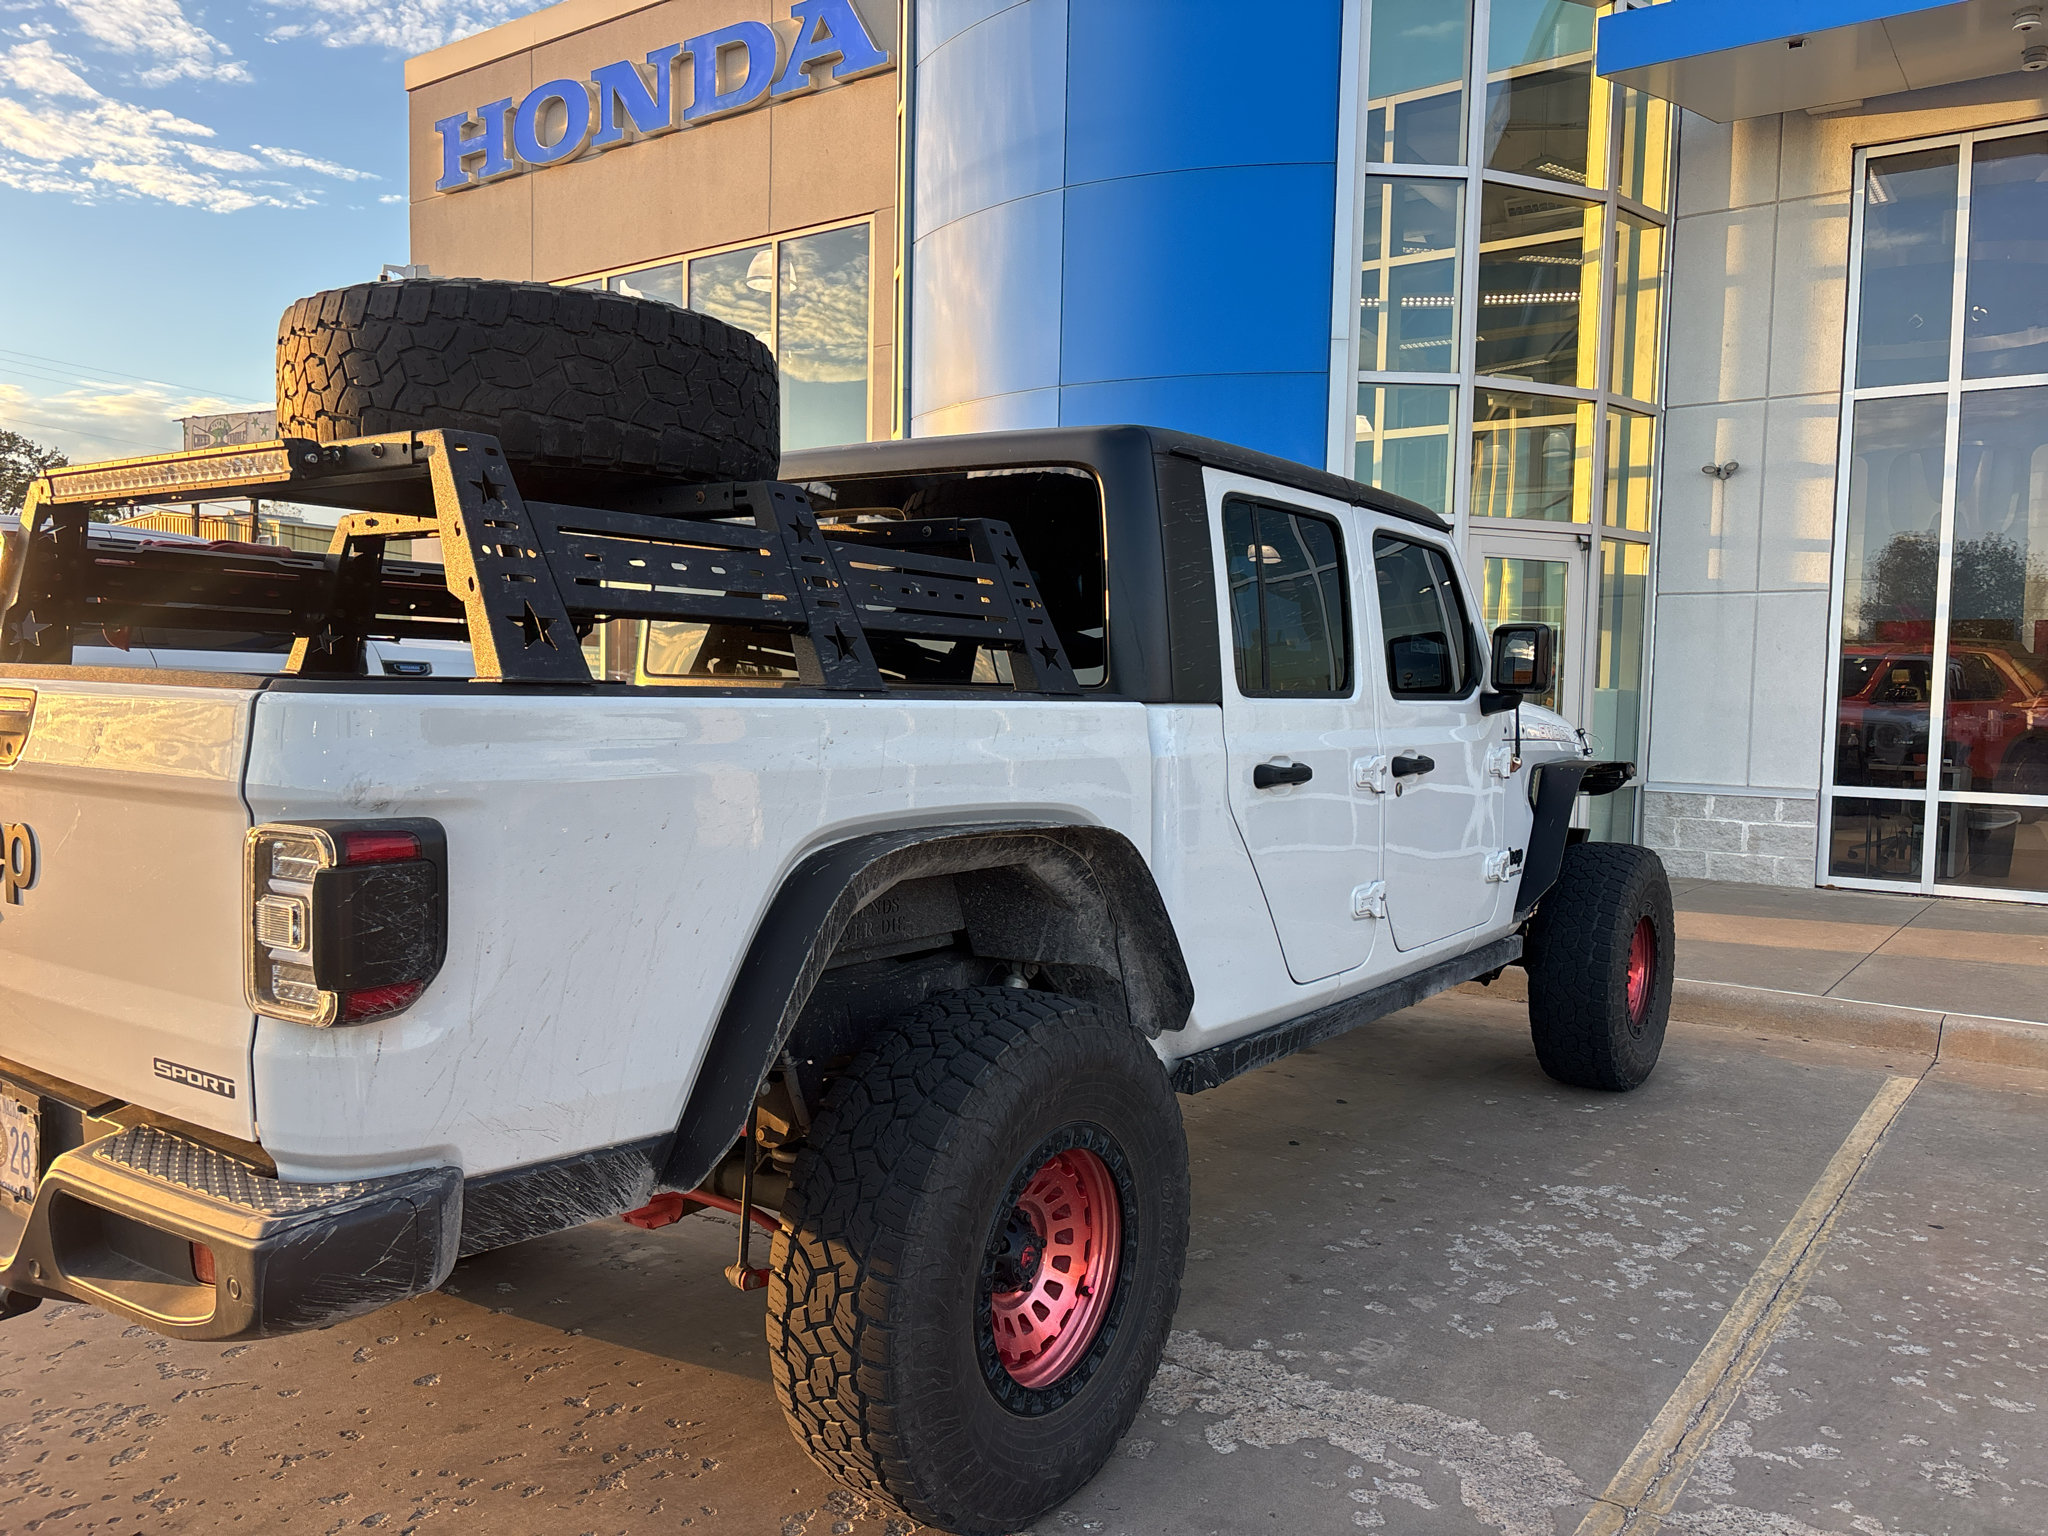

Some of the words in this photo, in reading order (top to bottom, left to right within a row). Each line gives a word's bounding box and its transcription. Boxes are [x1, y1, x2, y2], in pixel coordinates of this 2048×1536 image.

[434, 0, 891, 193] HONDA
[154, 1061, 235, 1095] SPORT
[10, 1126, 30, 1179] 28
